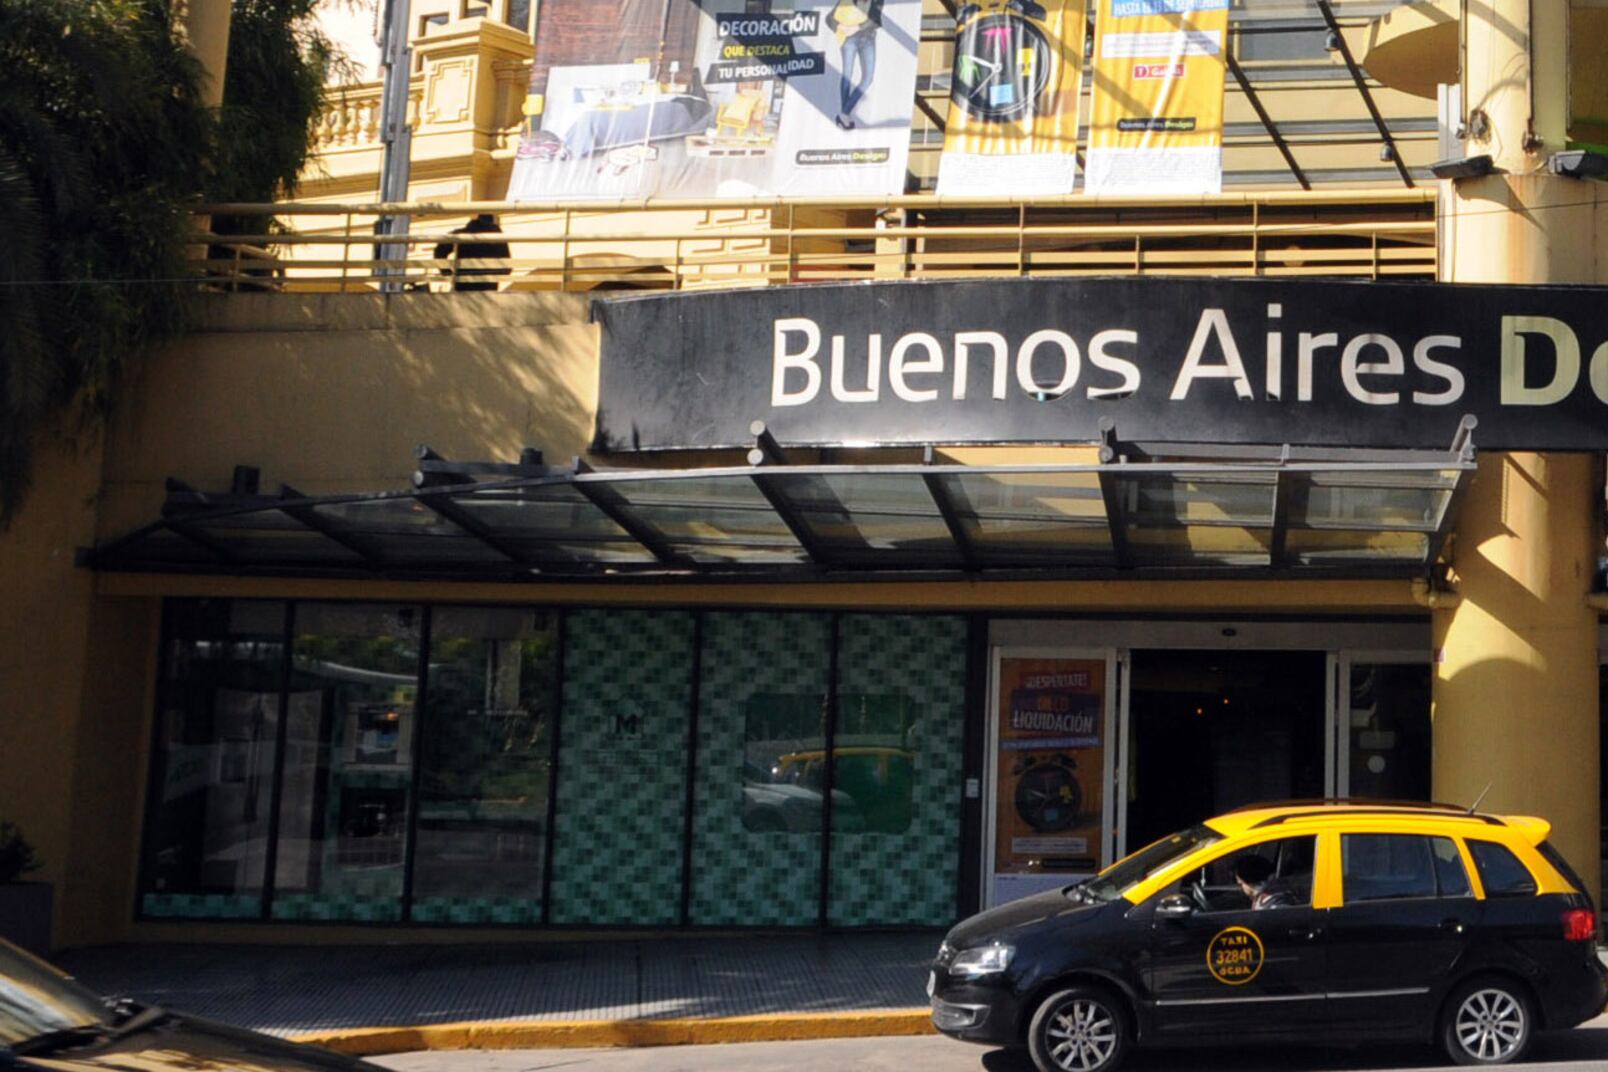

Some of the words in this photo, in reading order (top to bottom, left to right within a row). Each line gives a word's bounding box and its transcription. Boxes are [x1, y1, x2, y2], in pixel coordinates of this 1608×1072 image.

[1113, 1, 1141, 15] HASTA
[719, 12, 816, 37] DECORACIÓN
[723, 44, 745, 59] QUE
[746, 44, 790, 57] DESTACA
[718, 67, 733, 79] TU
[734, 58, 815, 79] PERSONALIDAD
[771, 317, 1140, 407] Buenos
[1169, 303, 1465, 405] Aires
[1013, 709, 1094, 733] LIQUIDACIÓN
[1220, 935, 1248, 946] TAXI
[1215, 947, 1253, 965] 32841
